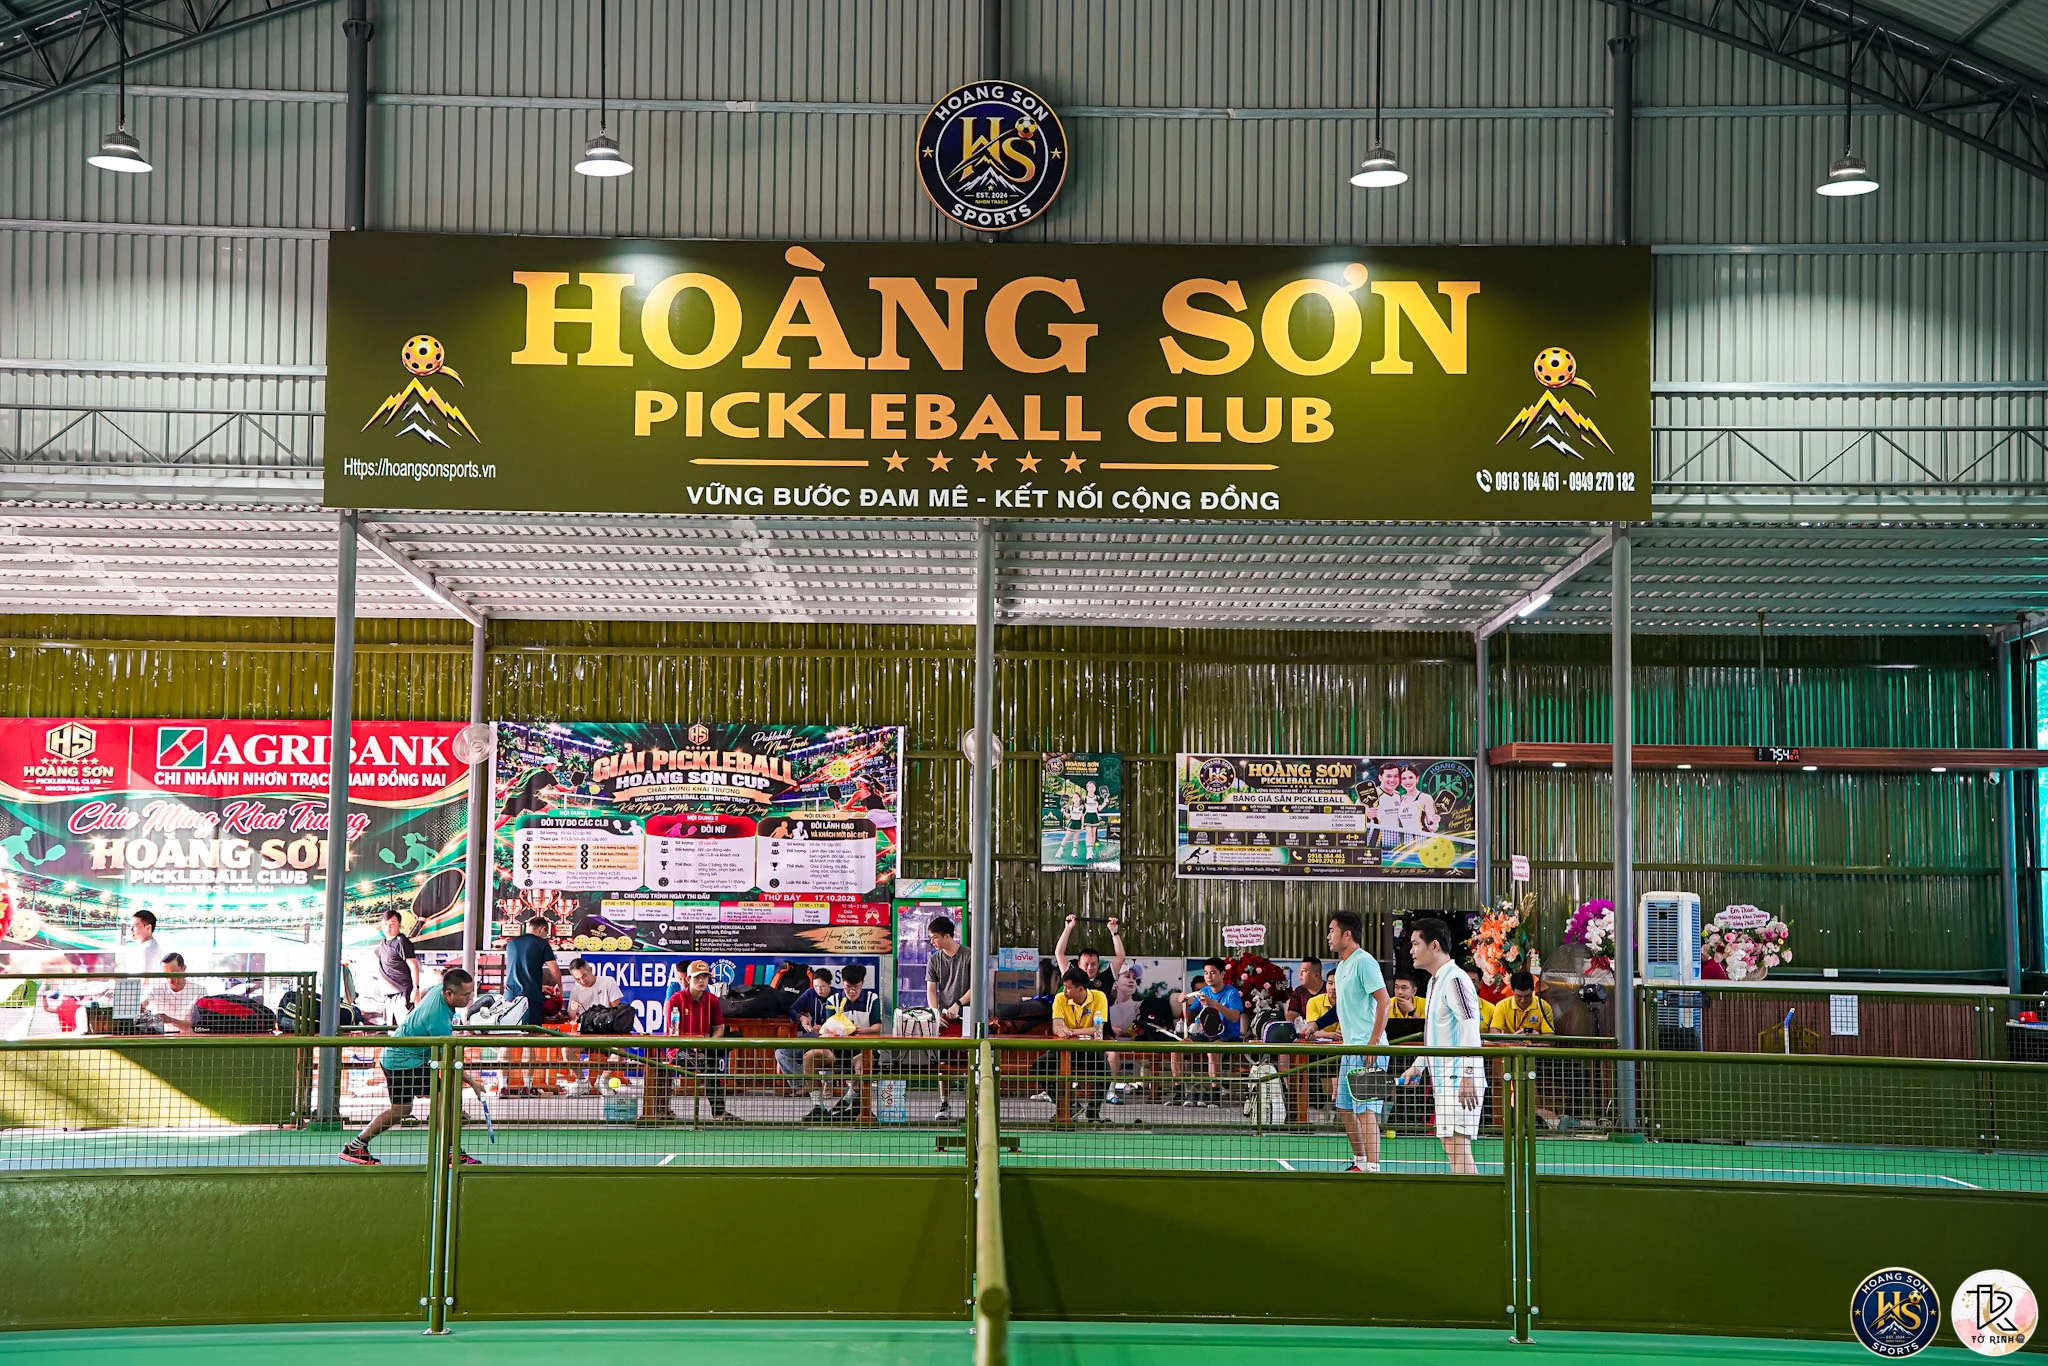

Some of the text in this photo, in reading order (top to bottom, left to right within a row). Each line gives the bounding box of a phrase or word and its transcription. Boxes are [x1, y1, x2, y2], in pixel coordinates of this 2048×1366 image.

[935, 86, 1049, 122] HOANG SON
[952, 203, 1031, 226] SPORTS
[511, 246, 1480, 377] HOÀNG SƠN
[634, 390, 1336, 444] PICKLEBALL CLUB
[343, 457, 496, 482] Https://hoangsonsports.vn
[1495, 470, 1519, 492] 0918
[1522, 470, 1539, 492] 164
[1541, 470, 1559, 492] 461
[1568, 470, 1593, 492] 0949
[1595, 470, 1613, 492] 270
[1615, 470, 1635, 492] 182
[687, 481, 765, 507] VỮNG
[773, 484, 851, 508] BƯỚC
[859, 488, 919, 508] ĐAM
[928, 485, 969, 508] MÊ
[995, 482, 1049, 510] KẾT
[1057, 483, 1104, 511] NỐI
[1112, 487, 1191, 516] CỘNG
[1200, 486, 1281, 513] ĐỒNG
[50, 725, 92, 758] HS
[23, 763, 114, 777] HOÀNG SƠN
[593, 743, 798, 786] GIẢI PICKLEBALL
[1248, 760, 1352, 778] HOÀNG SƠN
[1430, 763, 1470, 778] HOANG SON
[154, 772, 181, 785] CHI
[184, 769, 239, 785] NHÁNH
[243, 770, 289, 786] NHƠN
[291, 772, 331, 789] TRẠC
[377, 767, 419, 787] ĐỒNG
[422, 773, 446, 787] NAI
[616, 771, 770, 790] HOÀNG SƠN CUP
[1258, 794, 1272, 803] GIÁ
[1274, 794, 1289, 803] SÂN
[1291, 795, 1344, 803] PICKLEBALL
[68, 801, 140, 835] Chúc
[222, 801, 286, 835] Khai
[540, 818, 554, 826] ĐÔI
[555, 819, 565, 828] TỰ
[578, 818, 594, 826] CÁC
[701, 825, 727, 833] ĐÔI NỮ
[811, 821, 821, 829] ĐÔI
[841, 822, 854, 830] ĐẠO
[130, 869, 308, 885] PICKLEBALL CLUB
[764, 893, 781, 901] THỨ
[589, 962, 678, 987] PICKLEBA
